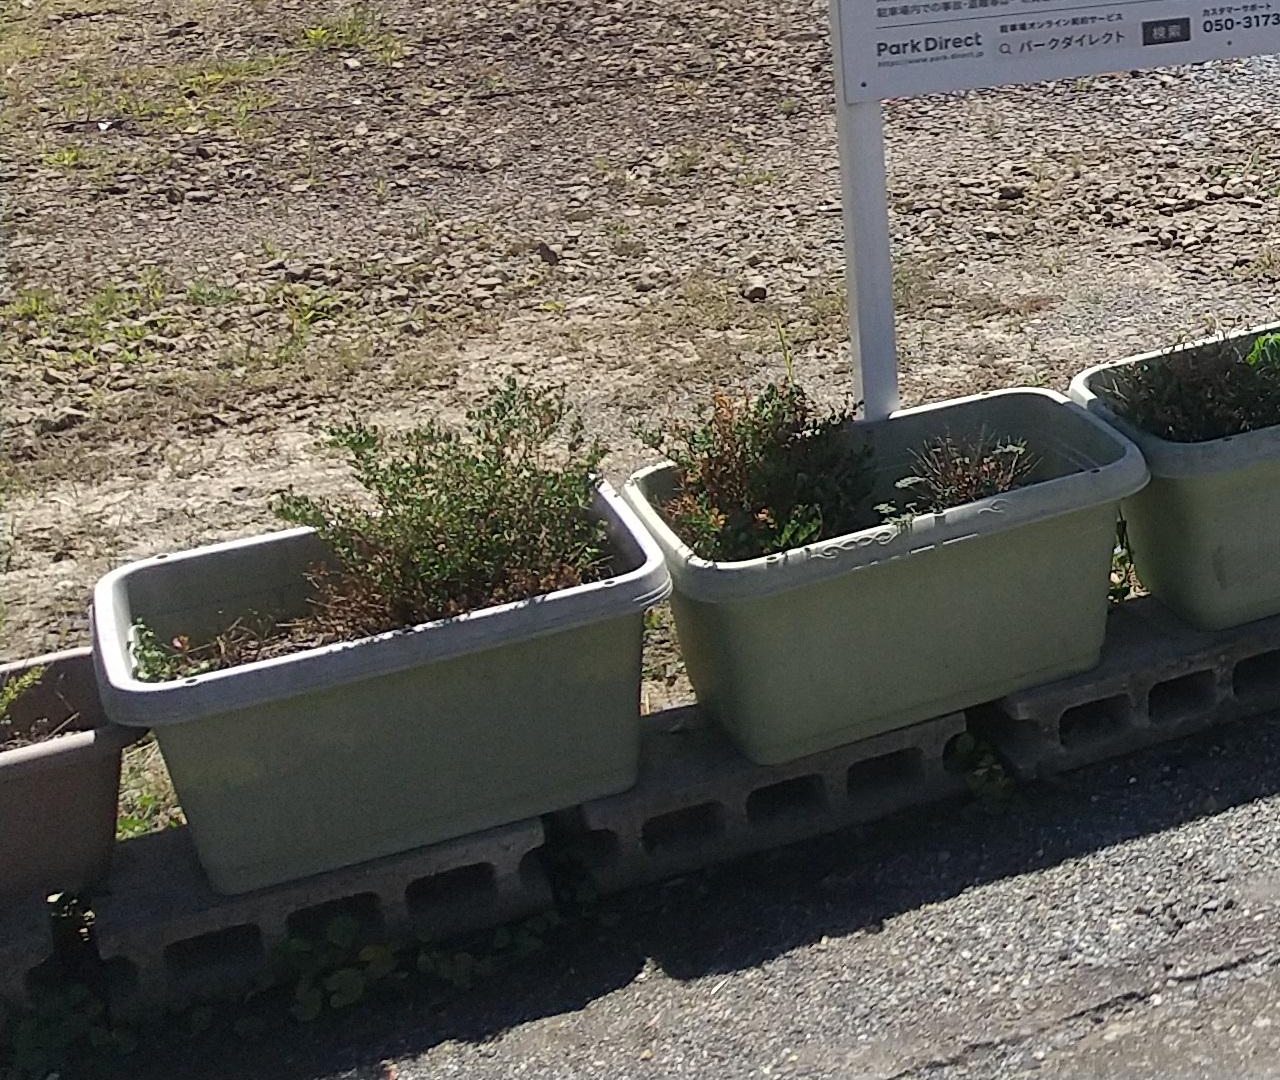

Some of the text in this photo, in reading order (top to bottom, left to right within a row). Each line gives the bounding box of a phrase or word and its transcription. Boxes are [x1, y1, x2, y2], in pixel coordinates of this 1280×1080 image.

[1202, 2, 1273, 17] カスタマーサポート
[1152, 23, 1182, 40] 検索
[876, 32, 983, 57] Park Direct
[1018, 30, 1126, 54] パークダイレクト
